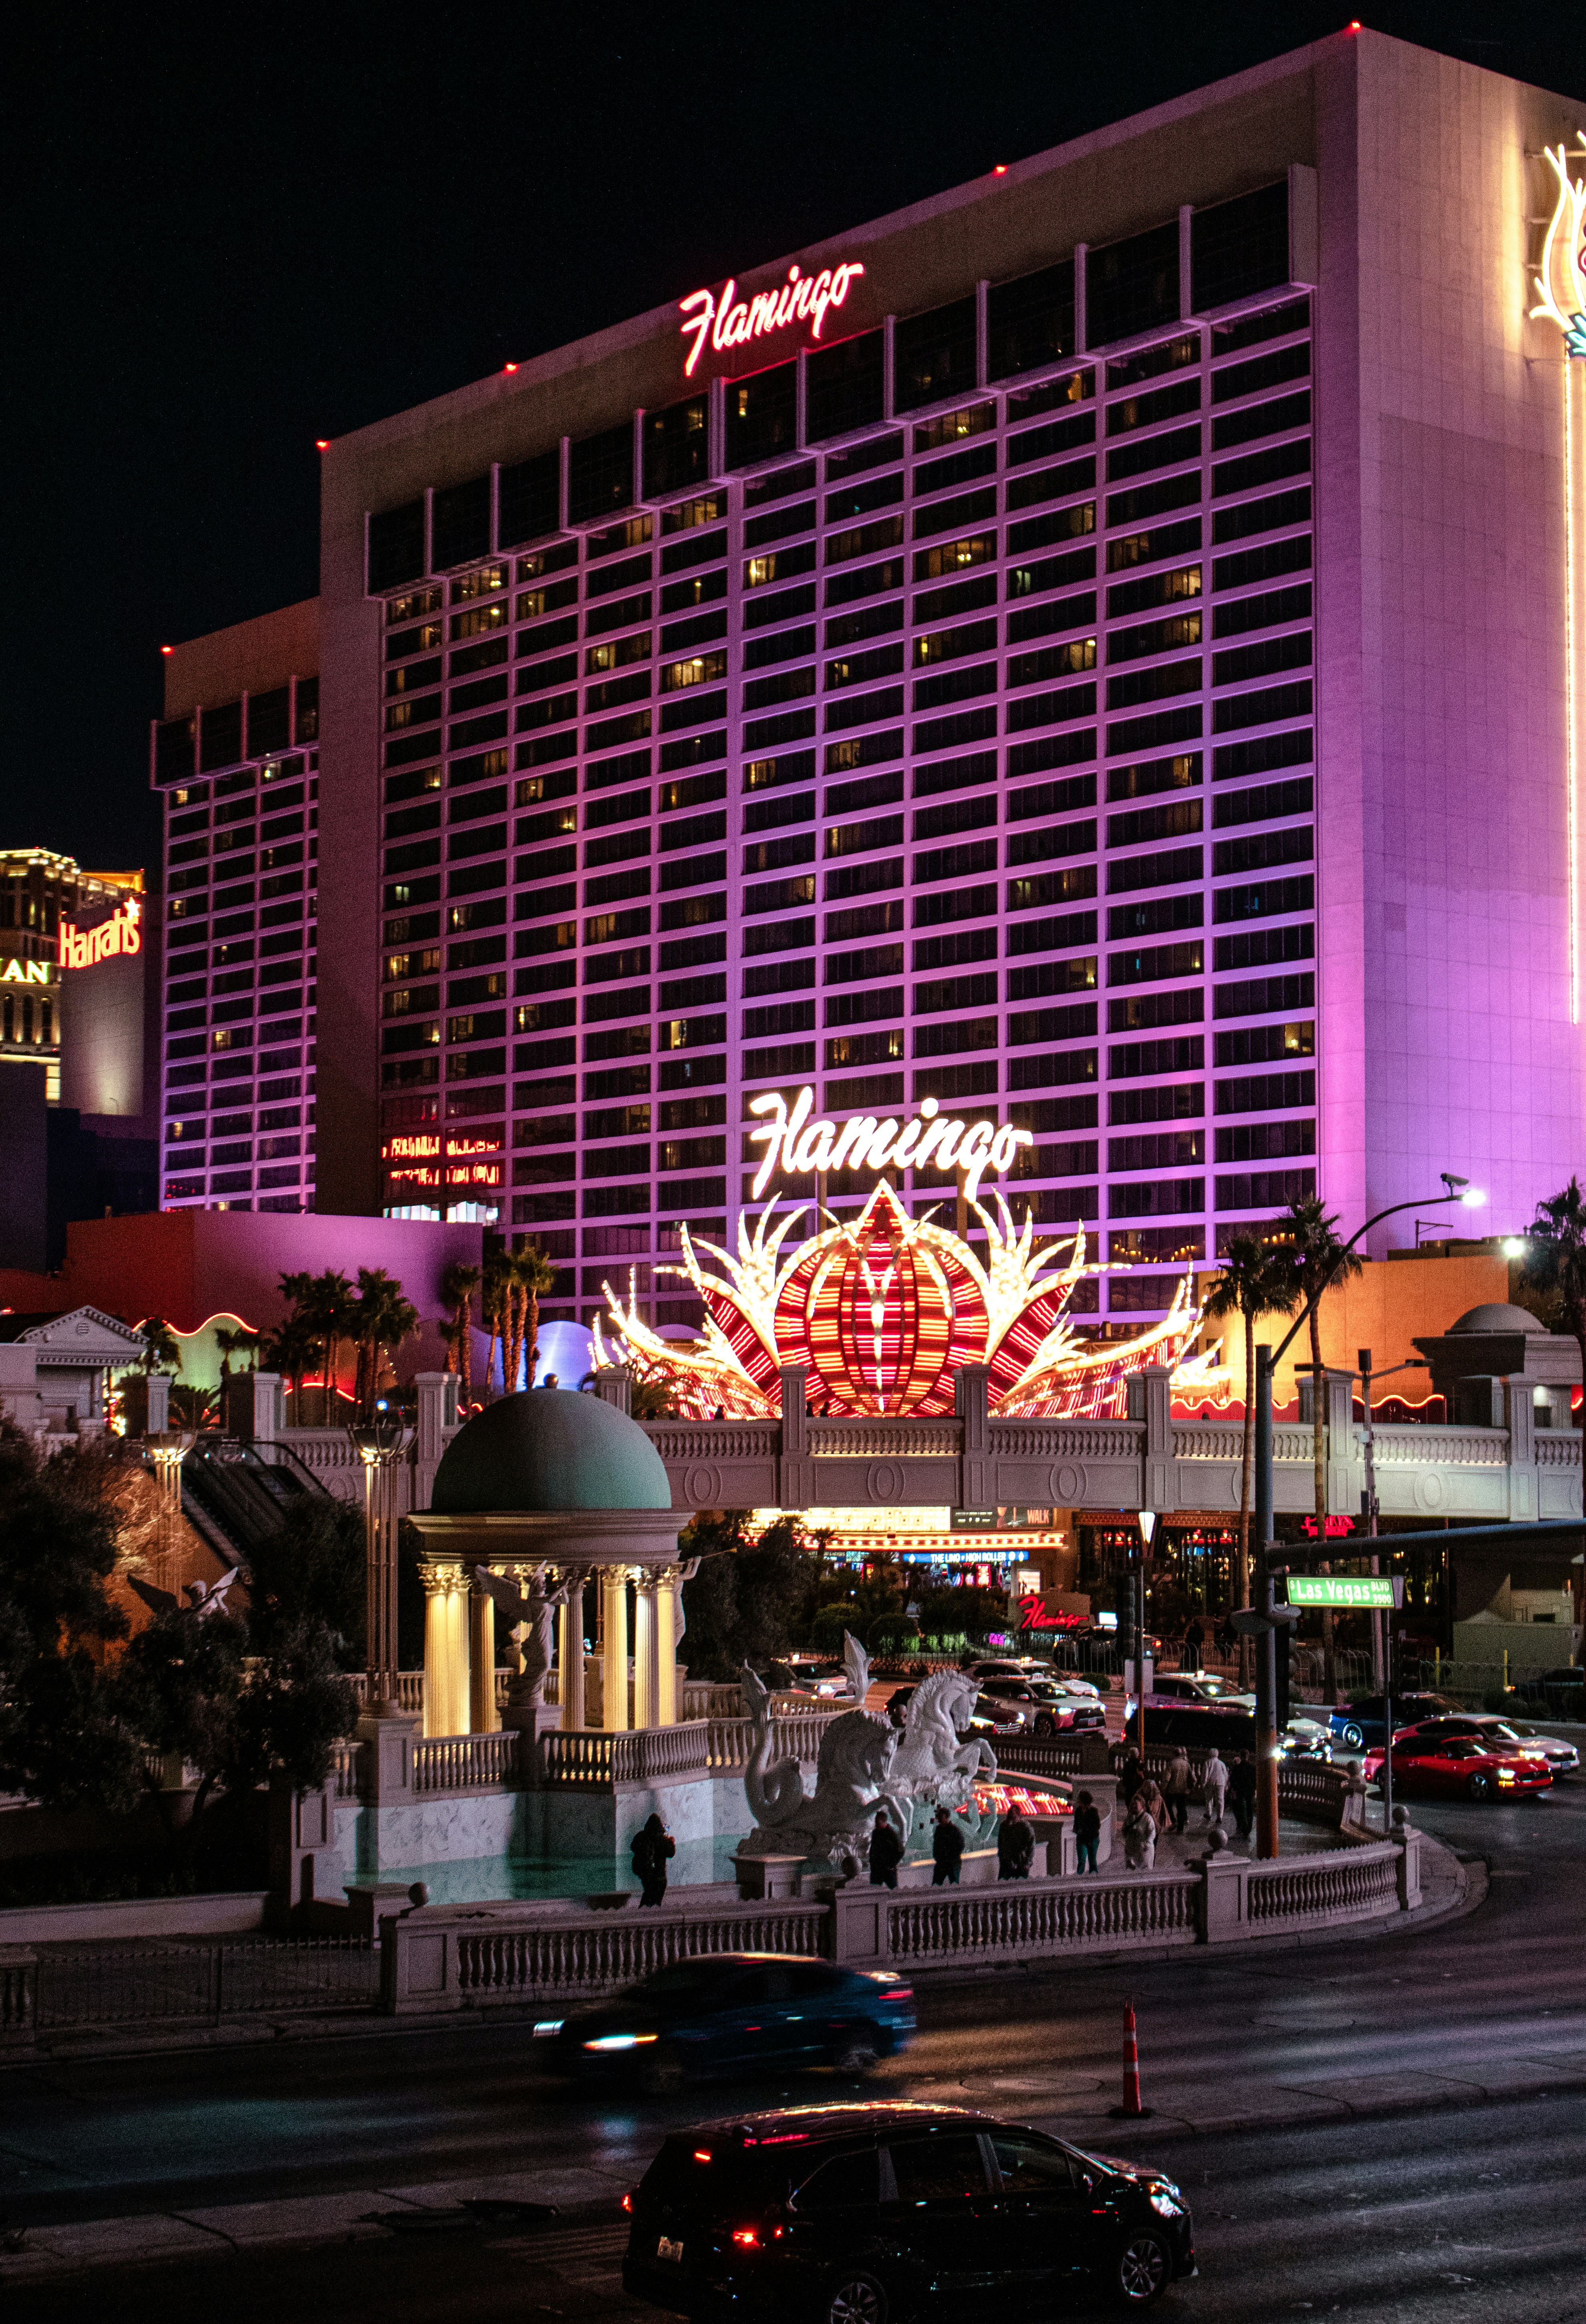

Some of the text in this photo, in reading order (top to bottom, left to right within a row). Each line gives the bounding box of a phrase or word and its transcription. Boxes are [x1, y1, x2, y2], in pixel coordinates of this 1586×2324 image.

[679, 262, 865, 378] Flamingo
[749, 1086, 1034, 1202] Flamingo
[1027, 1509, 1050, 1524] WALK
[931, 1553, 945, 1563] THE
[966, 1553, 982, 1562] HIGH
[982, 1552, 1007, 1561] ROLLER
[1290, 1580, 1390, 1605] S Las Vegas BLVD
[1372, 1594, 1392, 1604] 3500
[1019, 1595, 1088, 1629] Flamingo
